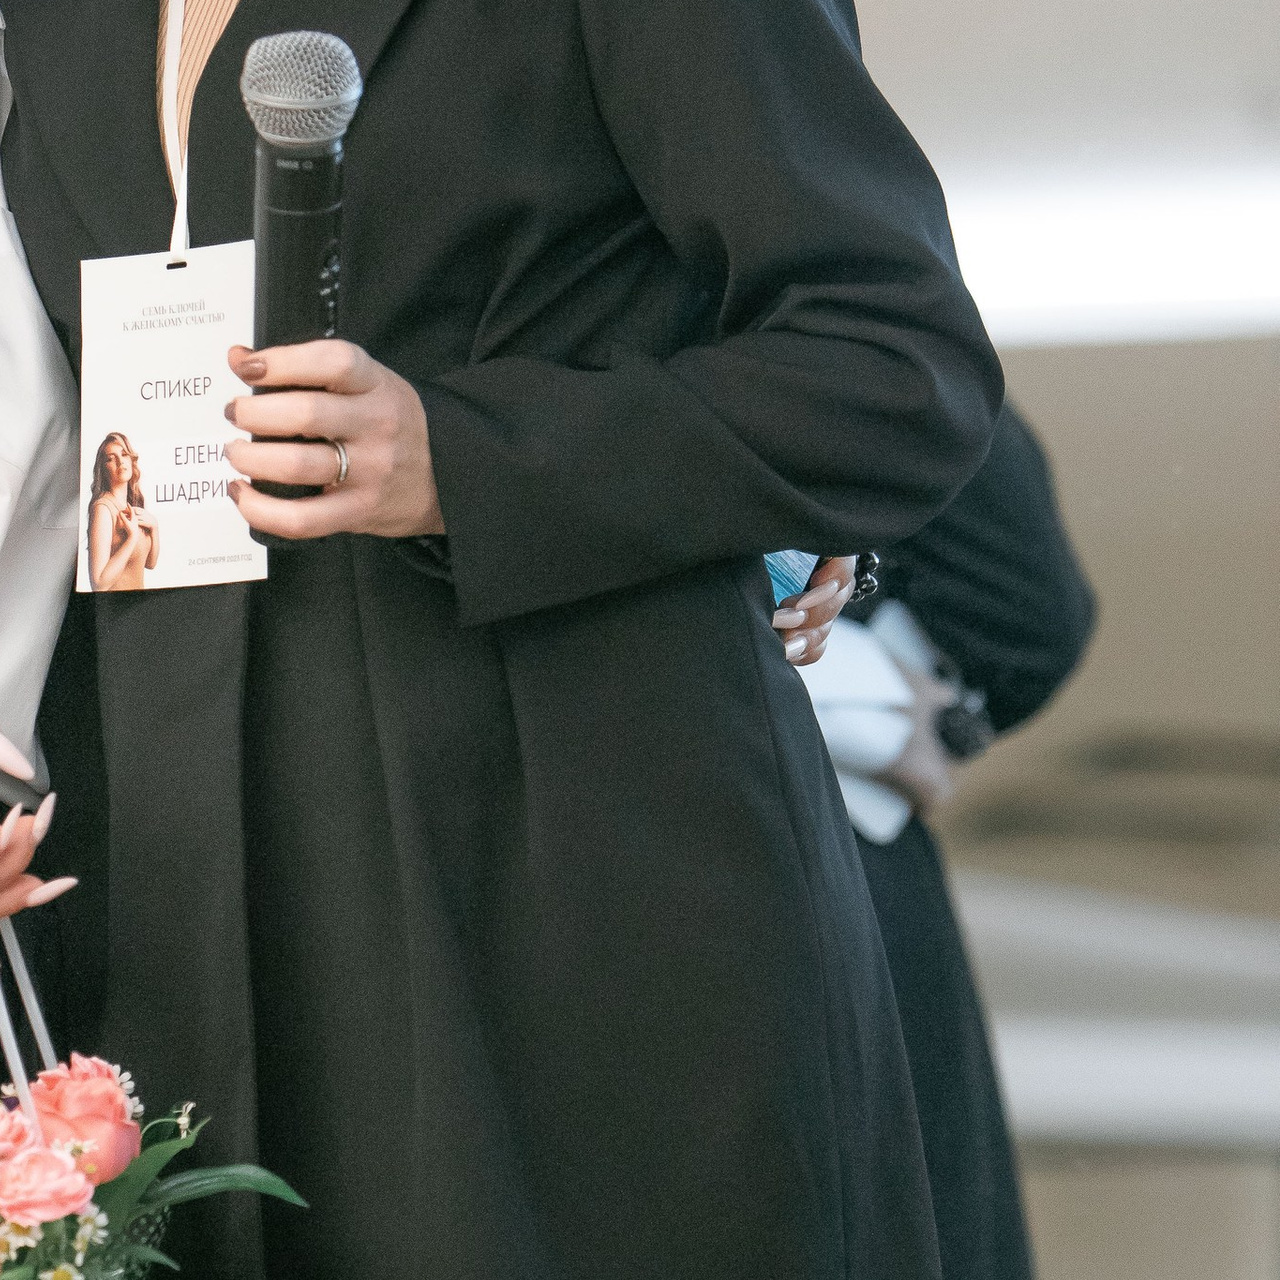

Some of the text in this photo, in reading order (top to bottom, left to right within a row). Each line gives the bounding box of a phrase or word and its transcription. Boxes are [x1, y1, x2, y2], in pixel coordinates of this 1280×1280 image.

[142, 299, 206, 317] СЕМЬ КЛЮЧЕЙ
[131, 317, 183, 331] ЖЕНСКОМУ
[185, 312, 225, 326] СЧАСТЬЮ
[140, 376, 212, 400] СПИКЕР
